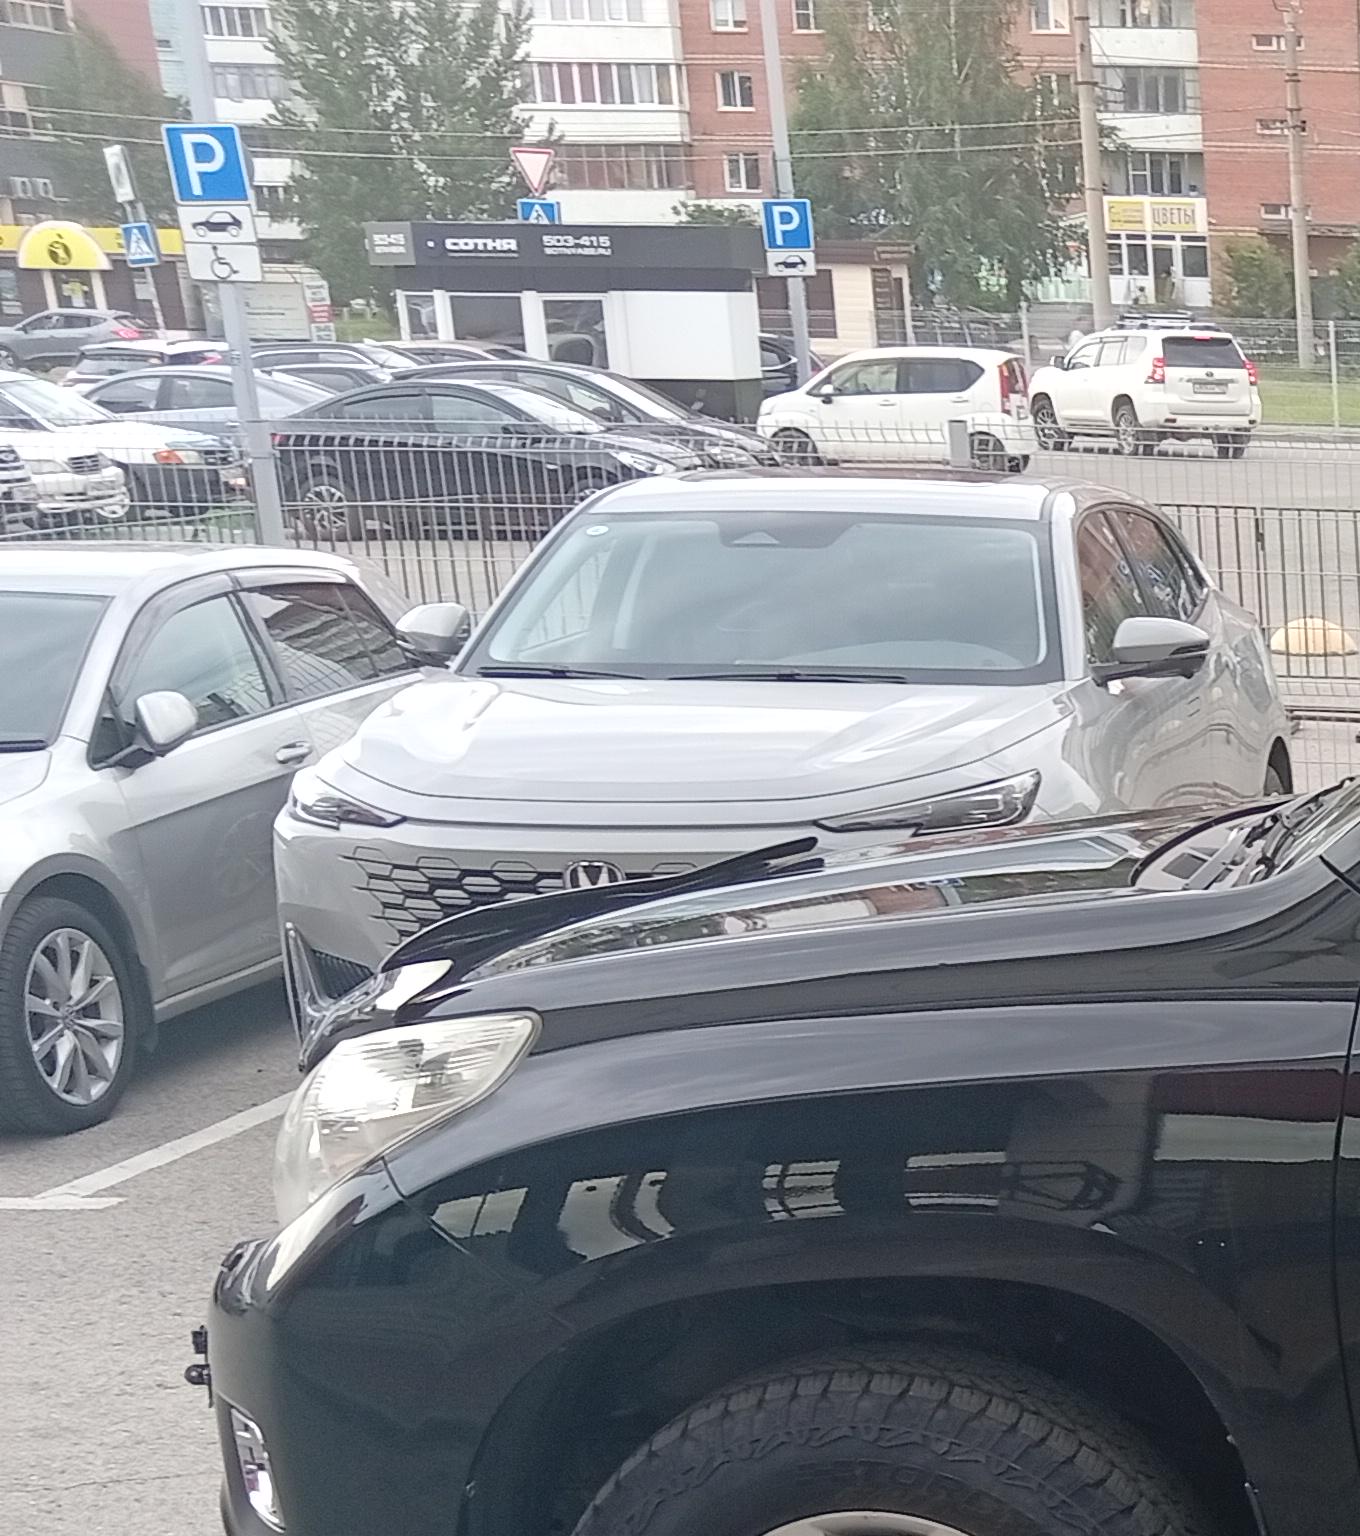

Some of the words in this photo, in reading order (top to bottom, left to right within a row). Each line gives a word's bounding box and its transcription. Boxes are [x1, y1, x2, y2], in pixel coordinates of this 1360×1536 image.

[181, 133, 226, 196] P
[772, 205, 800, 246] P
[1152, 207, 1196, 227] ЦВЕТЫ
[445, 238, 518, 251] СОТНЯ
[542, 235, 611, 247] 503-415
